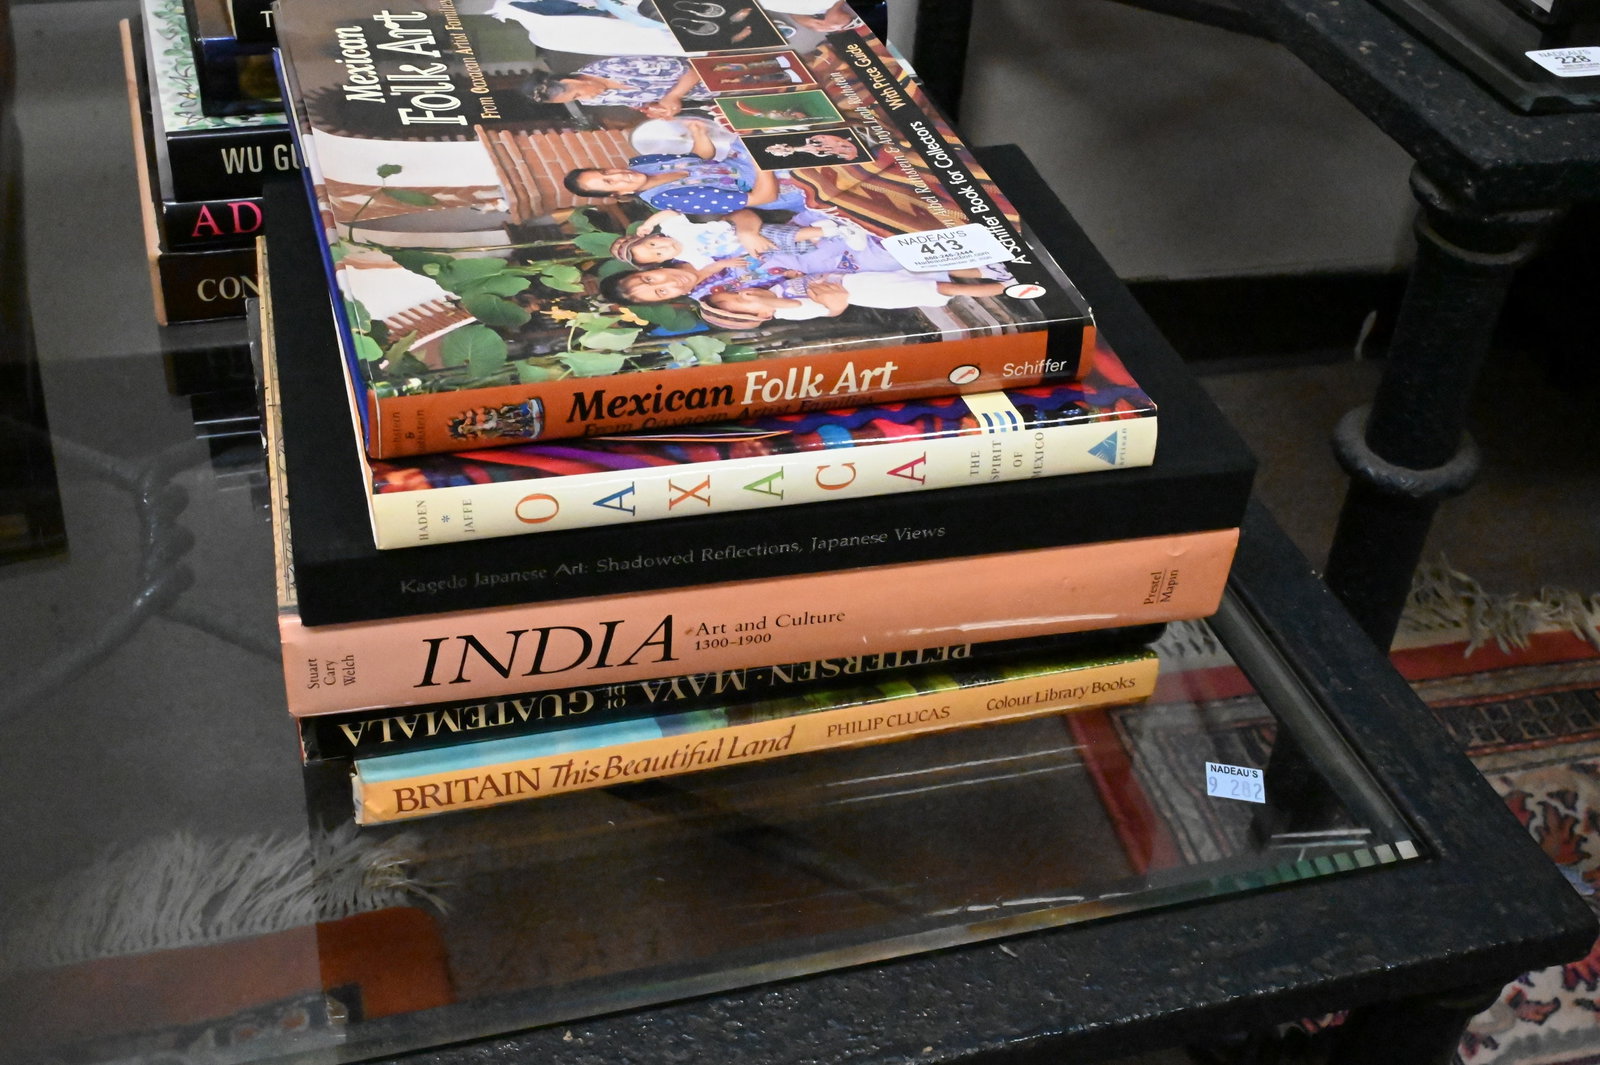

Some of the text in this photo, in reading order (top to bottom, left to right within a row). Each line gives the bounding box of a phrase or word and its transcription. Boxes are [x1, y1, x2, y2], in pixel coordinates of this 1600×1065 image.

[450, 33, 474, 55] Artist
[335, 25, 386, 103] Mexican
[373, 10, 468, 125] Folk Art
[463, 57, 490, 94] Oaxacan
[846, 43, 906, 111] With Price Guide
[479, 96, 501, 119] From
[871, 125, 895, 145] Anya
[884, 145, 900, 154] &
[910, 121, 953, 168] Collectors
[221, 146, 263, 175] WU
[947, 170, 967, 185] for
[958, 185, 990, 213] Book
[898, 230, 967, 246] NADEAU'S
[920, 239, 964, 255] 413
[1011, 254, 1032, 265] A
[566, 358, 1067, 424] Mexican Folk Art Schiffer
[970, 450, 981, 477] THE
[991, 441, 1002, 480] SPIRIT
[1013, 452, 1023, 467] OF
[1031, 432, 1045, 479] MEXICO
[418, 499, 429, 542] HADEN
[463, 498, 476, 533] JAFFE
[400, 526, 946, 595] Kagedo Japanese Art: Shadowed Reflections, Japanese Views
[1143, 571, 1162, 605] Prestel
[1160, 569, 1179, 603] Mapin
[695, 611, 846, 636] Art and Culture
[413, 614, 680, 688] INDIA
[695, 633, 772, 651] 1300-1900
[307, 658, 321, 690] Stuart
[323, 659, 337, 686] Cary
[343, 654, 355, 687] Welch
[769, 642, 973, 686] PETTERSEN
[640, 667, 748, 703] MAYA
[337, 690, 595, 748] GUATEMALA
[393, 676, 1136, 814] BRITAIN This Beautiful Land PHILIP CLUCAS Colour Library Books
[1208, 776, 1218, 793] 9
[1210, 764, 1259, 778] NADEAU'S
